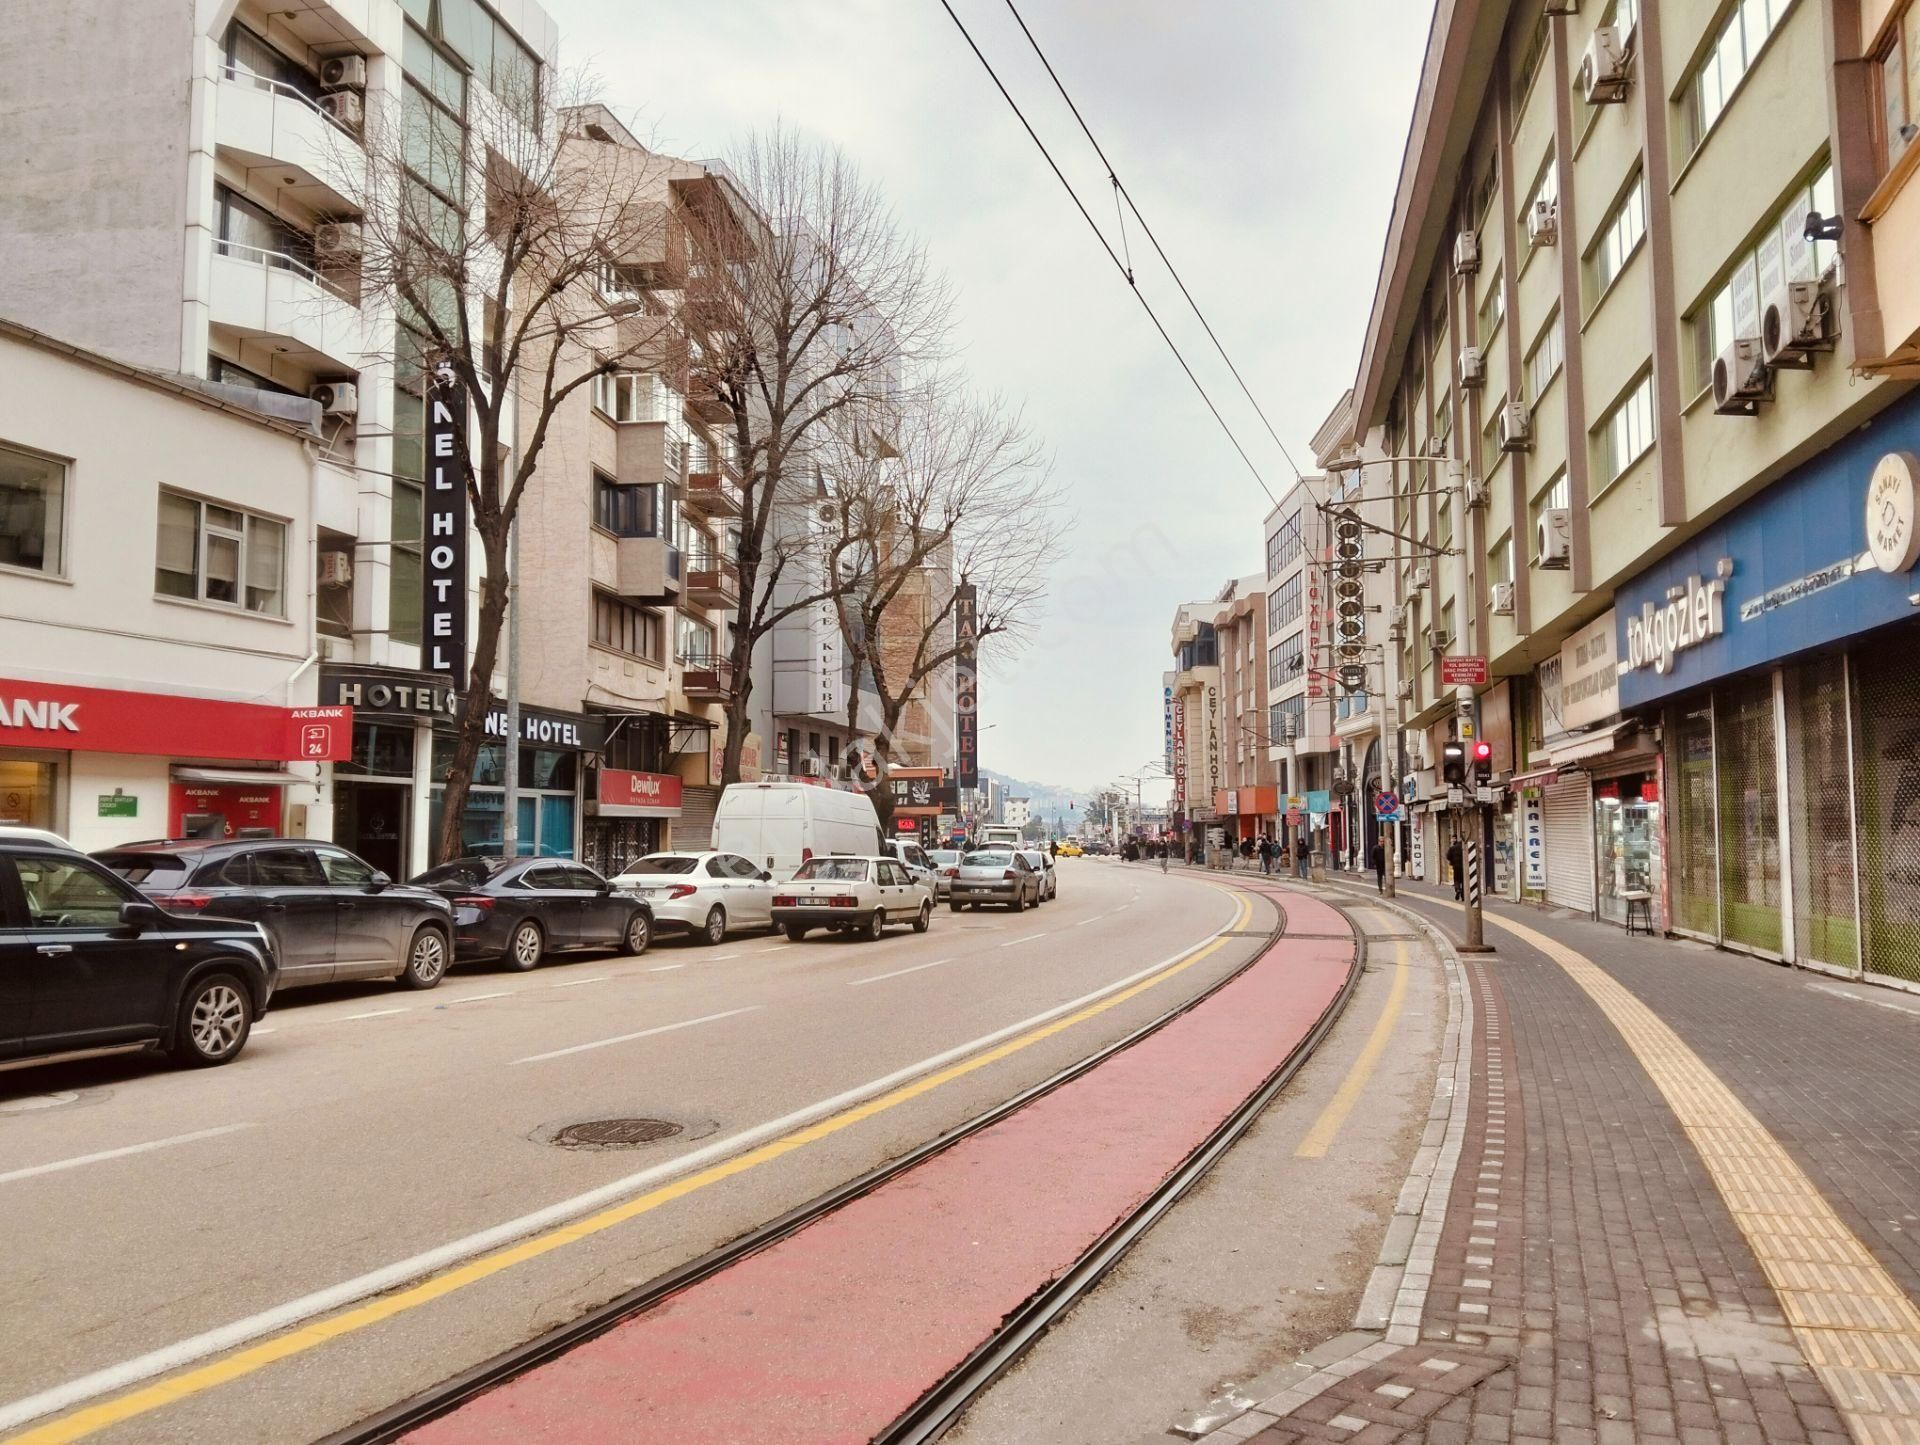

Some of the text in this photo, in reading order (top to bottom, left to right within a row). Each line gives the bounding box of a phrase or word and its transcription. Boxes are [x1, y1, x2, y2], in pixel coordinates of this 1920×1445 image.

[1877, 517, 1905, 553] MARKET
[430, 513, 454, 669] HOTEL
[1309, 571, 1319, 666] LUXURY
[1628, 574, 1725, 675] tokgözler
[339, 683, 443, 712] HOTEL
[822, 643, 833, 712] KULÜBÜ
[291, 709, 343, 718] AKBANK
[526, 717, 581, 745] HOTEL
[1176, 705, 1184, 755] CEYLAN
[309, 744, 322, 754] 24
[1208, 687, 1219, 806] CEYLAN HOTEL
[185, 788, 219, 796] AKBANK
[631, 775, 660, 797] Dewilux
[1527, 800, 1541, 872] HASRET
